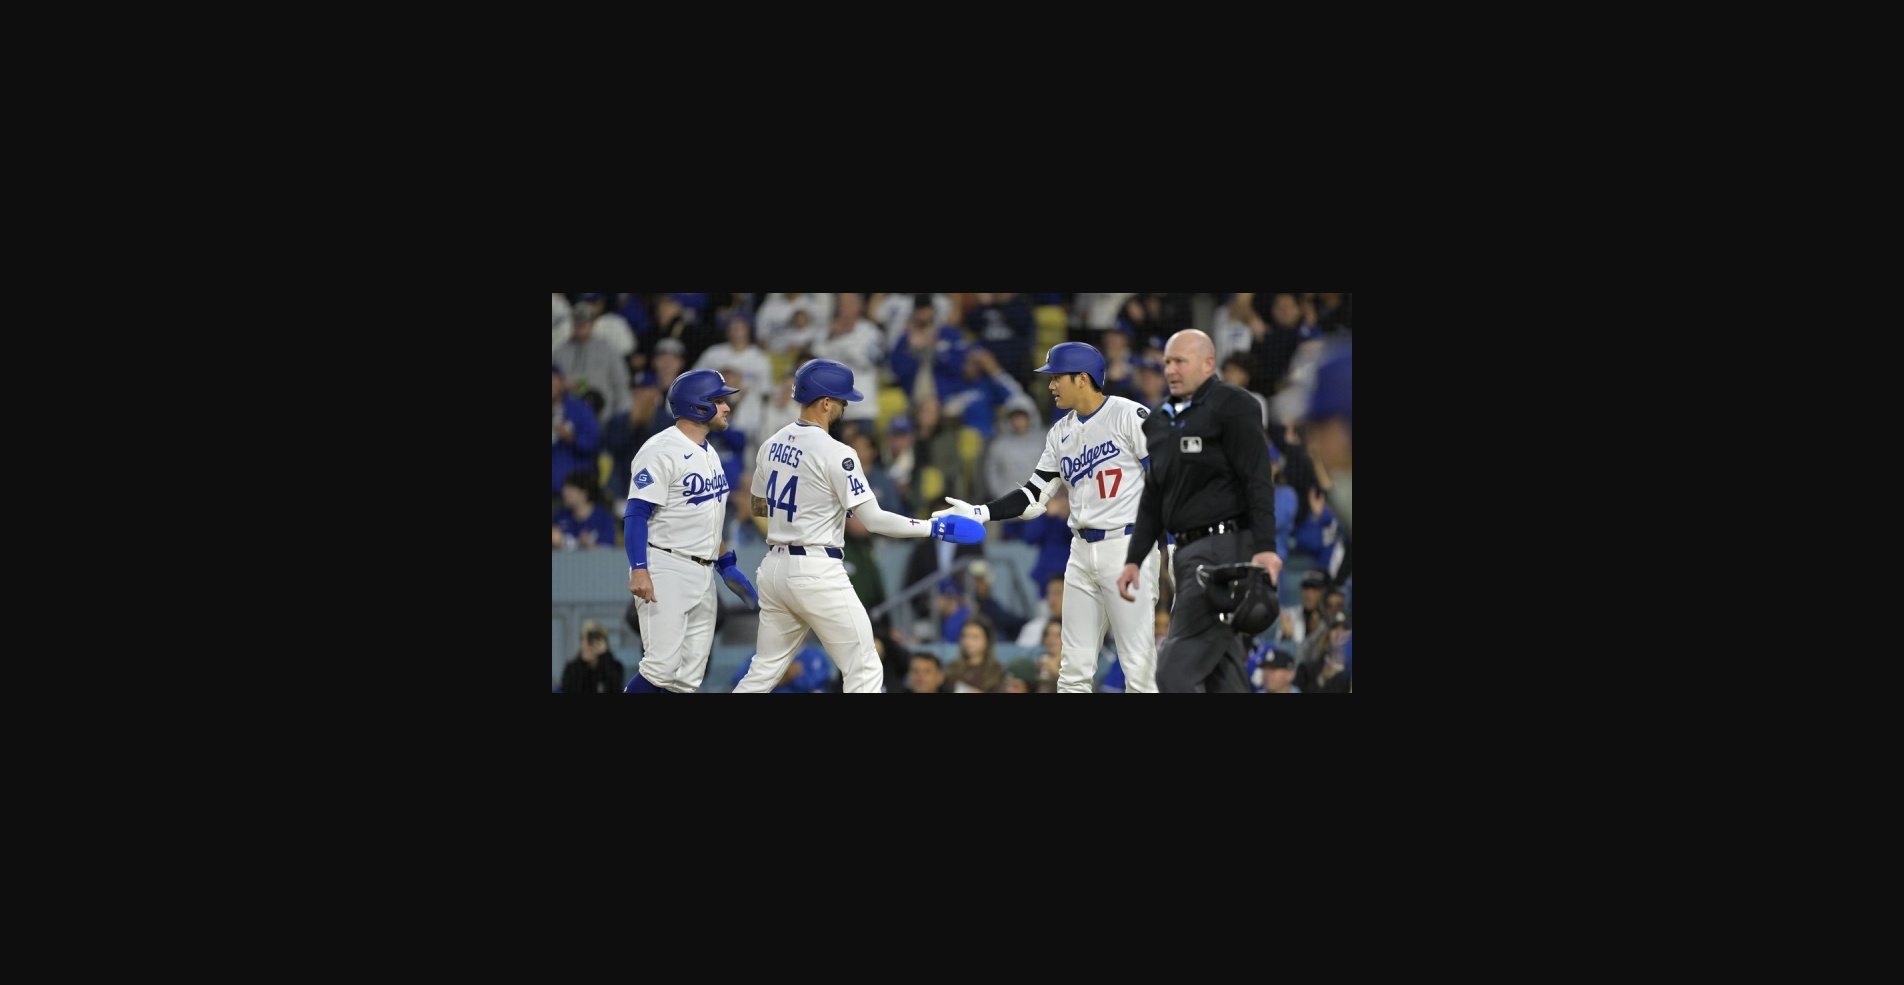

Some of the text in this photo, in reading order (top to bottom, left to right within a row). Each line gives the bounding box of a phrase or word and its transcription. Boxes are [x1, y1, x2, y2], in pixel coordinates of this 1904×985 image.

[768, 443, 802, 469] PAGES
[1060, 440, 1120, 483] Dodgers
[766, 470, 798, 522] 44
[847, 475, 865, 496] LA
[1096, 468, 1122, 499] 17
